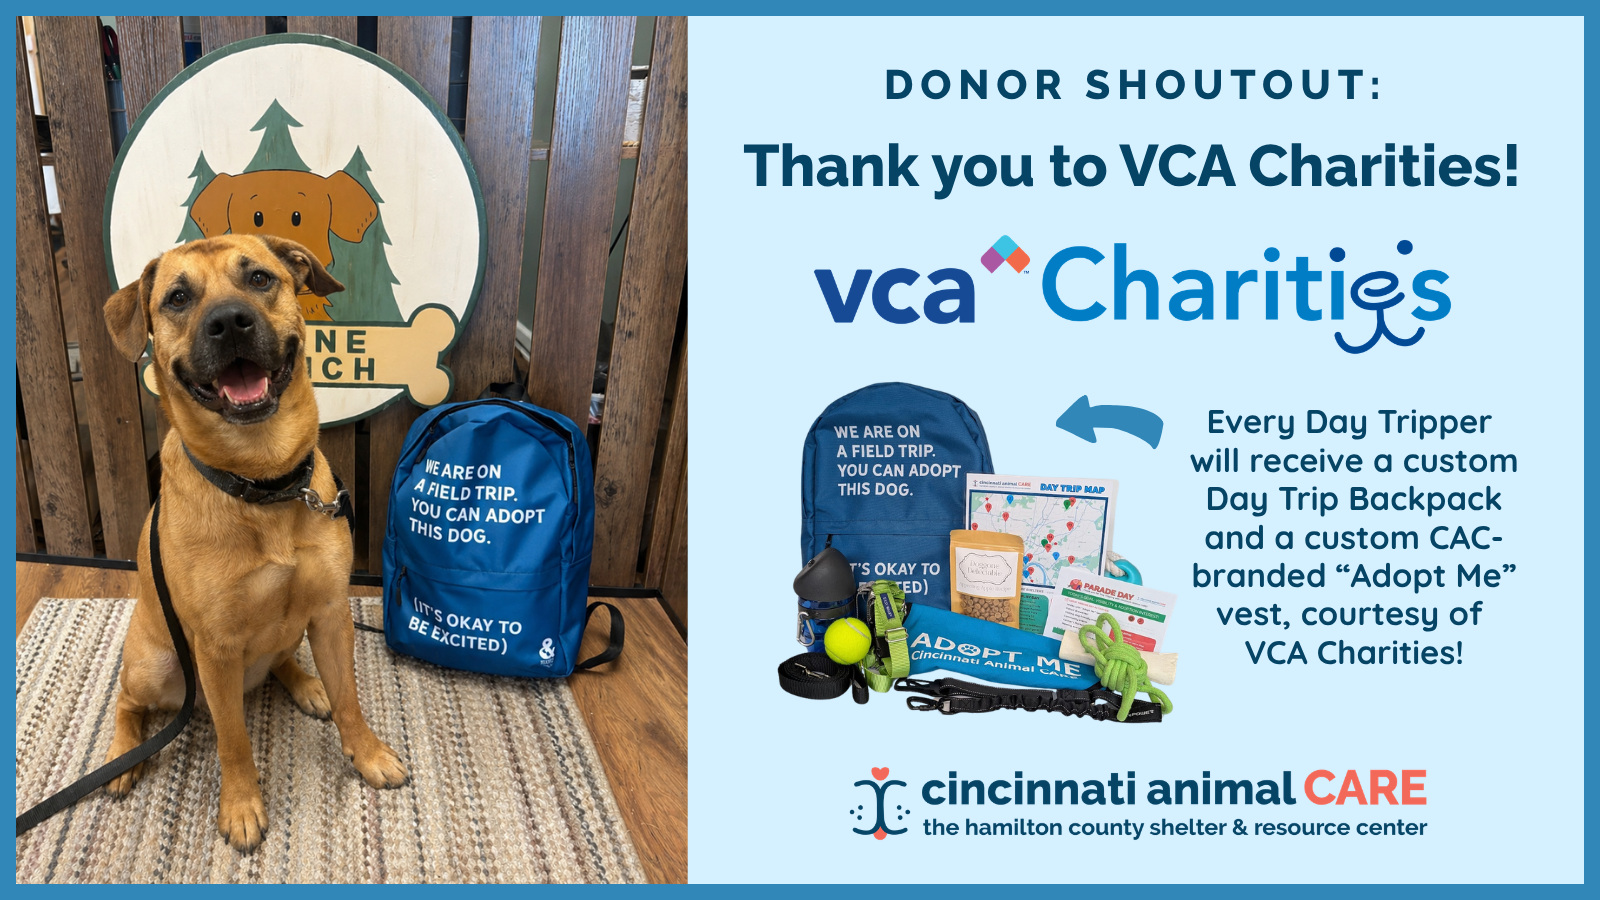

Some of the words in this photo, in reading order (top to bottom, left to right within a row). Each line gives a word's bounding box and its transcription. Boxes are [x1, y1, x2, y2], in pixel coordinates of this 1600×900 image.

[834, 425, 859, 438] WE
[863, 425, 893, 439] ARE
[897, 424, 920, 438] ON
[836, 445, 848, 457] A
[852, 444, 894, 458] FIELD
[898, 444, 936, 458] TRIP.
[425, 458, 440, 475] WE
[441, 463, 475, 481] ARE
[476, 464, 502, 479] ON
[837, 464, 868, 477] YOU
[872, 464, 905, 477] CAN
[908, 463, 961, 478] ADOPT
[414, 478, 426, 493] A
[426, 481, 471, 501] FIELD
[474, 485, 518, 502] TRIP.
[837, 482, 871, 496] THIS
[875, 482, 914, 497] DOG.
[1040, 483, 1058, 492] DAY
[1060, 484, 1082, 493] TRIP
[1084, 485, 1105, 494] MAP
[411, 497, 441, 520] YOU
[445, 507, 480, 522] CAN
[485, 508, 546, 524] ADOPT
[409, 517, 443, 541] THIS
[447, 527, 491, 545] DOG.
[874, 562, 917, 576] OKAY
[921, 562, 941, 576] TO
[1084, 582, 1117, 597] PARADE
[1117, 590, 1135, 601] DAY
[414, 596, 443, 624] (IT'S
[446, 613, 494, 633] OKAY
[498, 620, 523, 635] TO
[408, 615, 430, 636] BE
[430, 626, 508, 655] EXCITED)
[910, 632, 1023, 663] ADOPT
[1037, 655, 1082, 677] ME
[911, 650, 980, 665] Cincinnati
[984, 660, 1035, 673] Animal
